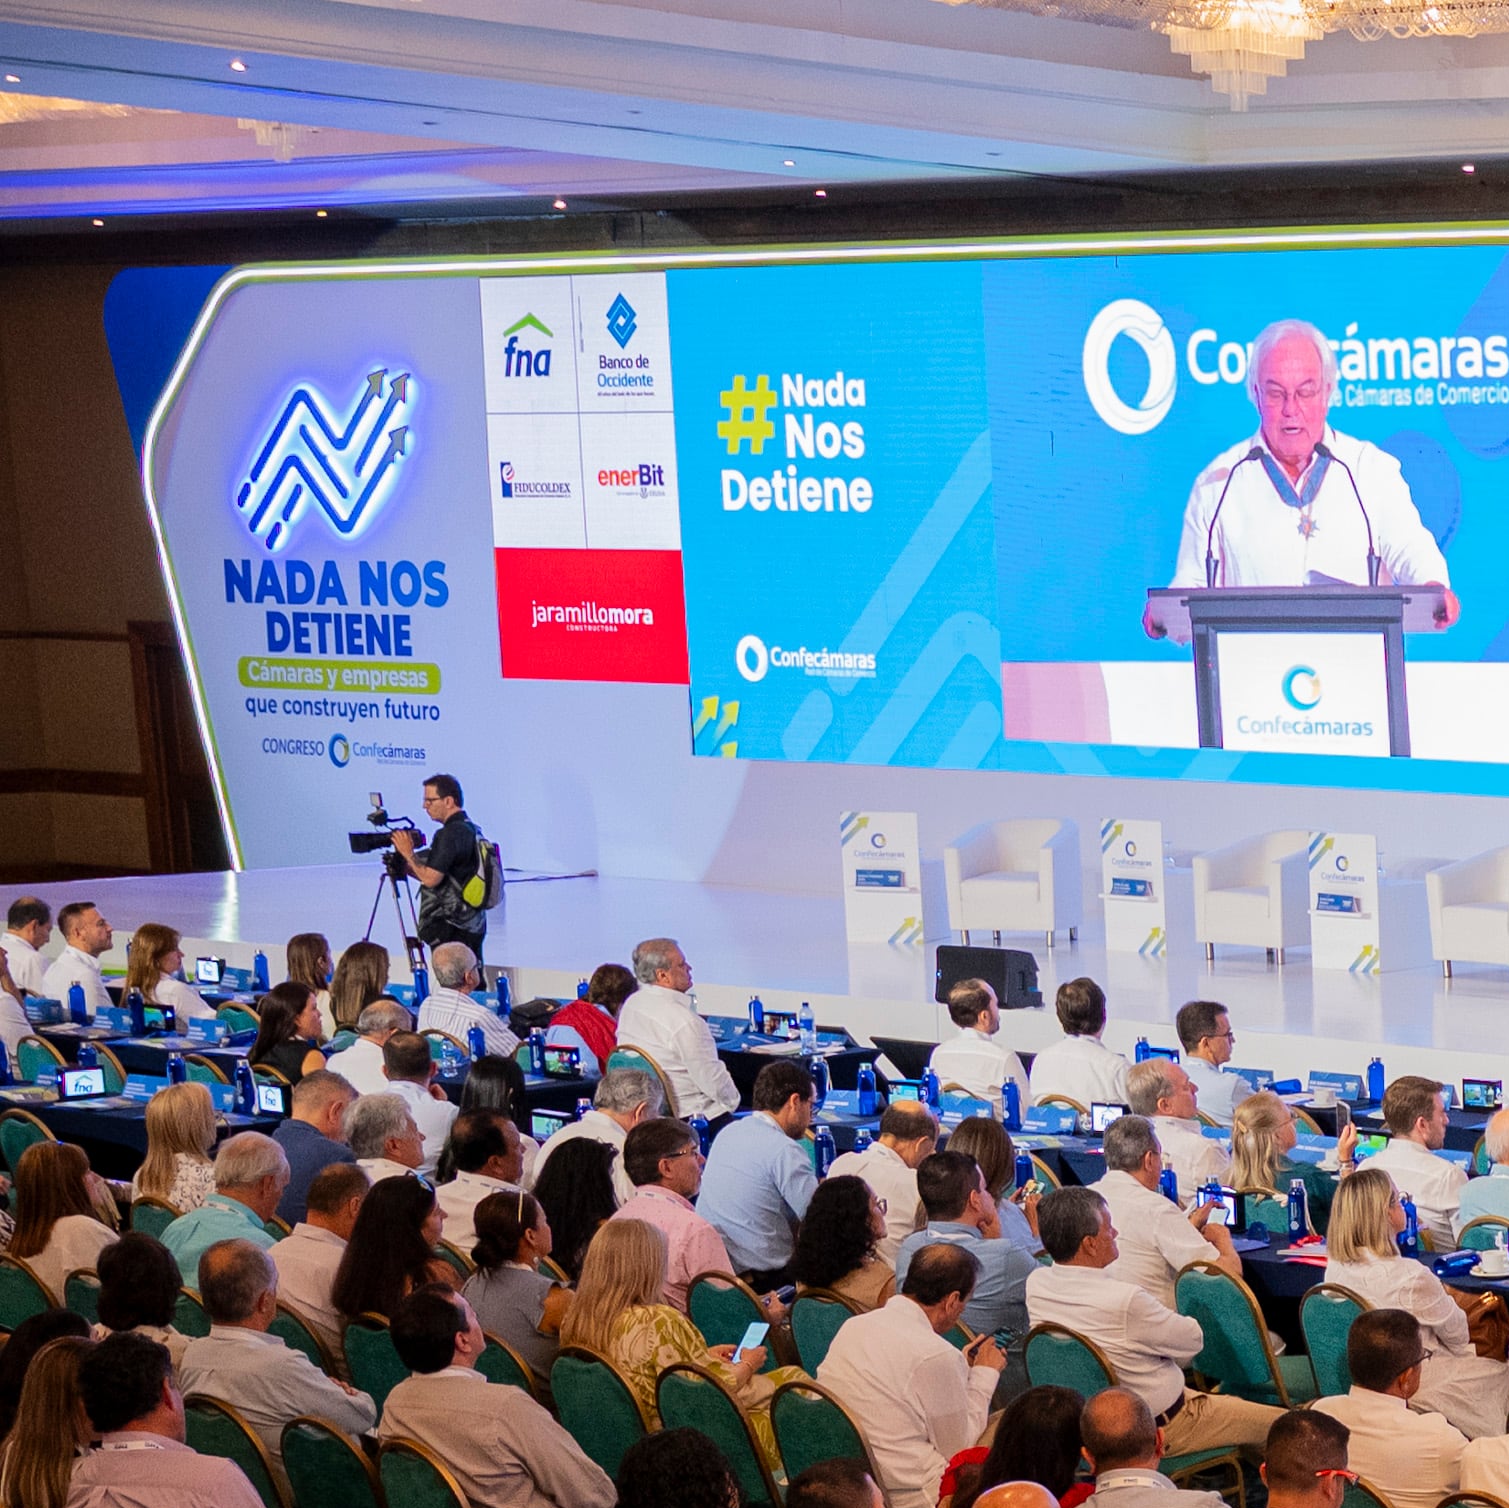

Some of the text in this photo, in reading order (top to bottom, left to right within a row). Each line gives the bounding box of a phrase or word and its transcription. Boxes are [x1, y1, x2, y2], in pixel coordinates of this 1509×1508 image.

[504, 336, 552, 378] fna
[600, 354, 649, 369] Banco de
[597, 373, 654, 387] Occidente
[782, 372, 866, 408] Nada
[1345, 382, 1412, 407] Cámaras
[1415, 384, 1434, 406] de
[785, 413, 865, 459] Nos
[514, 482, 571, 494] FIDUCOLDEX
[598, 464, 665, 487] enerBit
[720, 467, 874, 514] Detiene
[223, 558, 449, 608] NADA NOS
[532, 601, 654, 628] jaramillomora
[266, 611, 413, 657] DETIENE
[770, 646, 877, 670] Confecámaras
[247, 660, 428, 691] Cámaras y empresas
[245, 697, 440, 723] que construyen futuro
[1236, 715, 1374, 737] Confecámaras
[262, 737, 427, 760] CONGRESO Confecámaras
